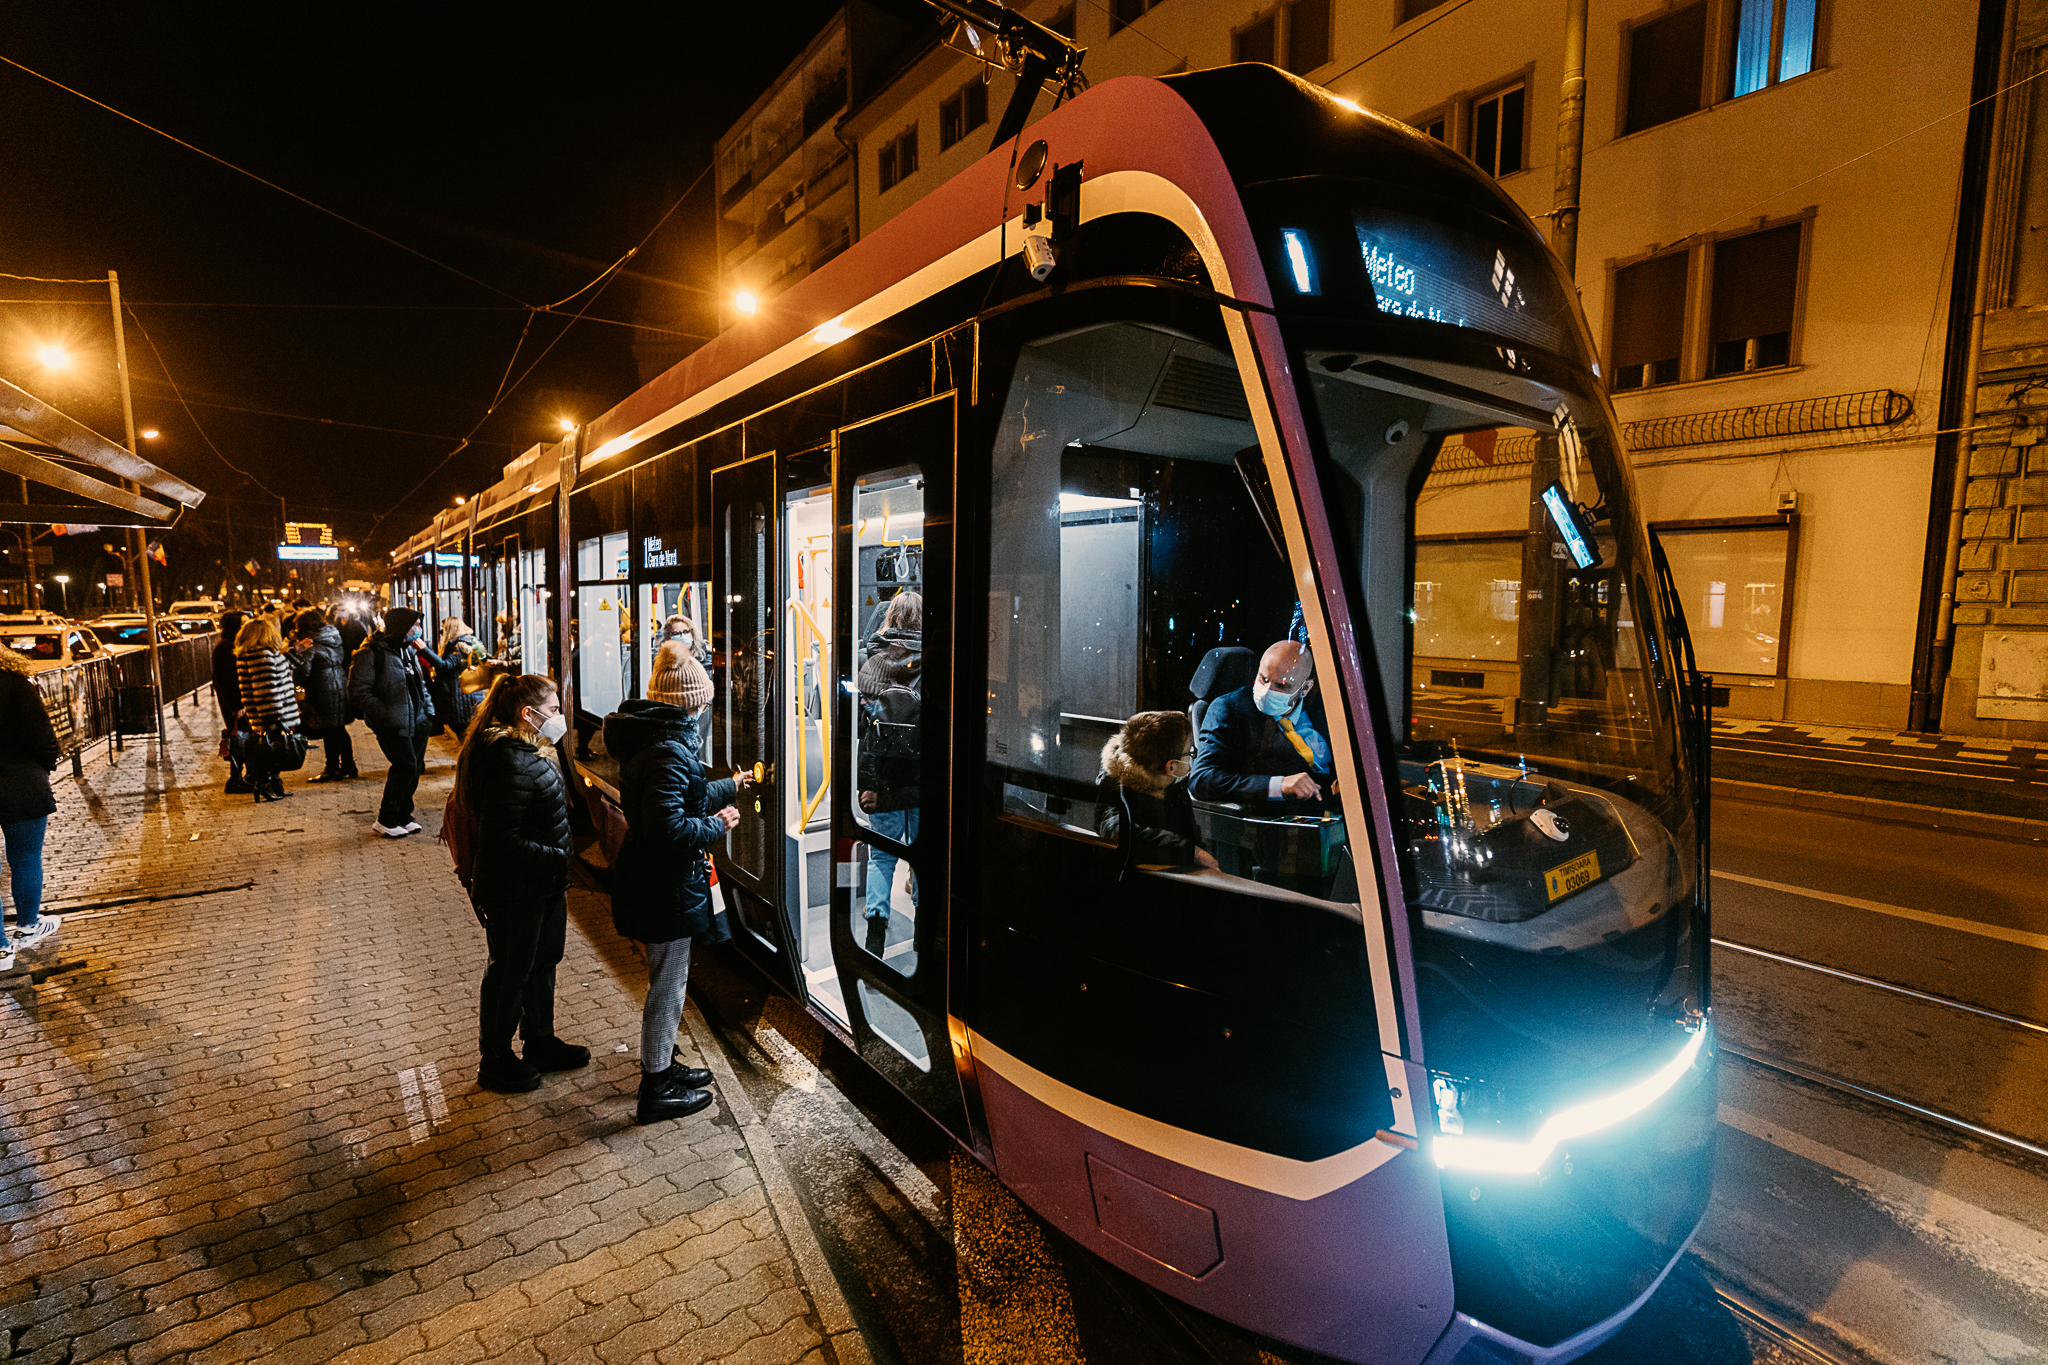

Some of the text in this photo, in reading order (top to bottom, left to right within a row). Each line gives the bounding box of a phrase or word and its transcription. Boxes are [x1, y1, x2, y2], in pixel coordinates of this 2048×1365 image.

[1362, 241, 1415, 295] Meteo
[648, 536, 662, 551] Meteo
[1566, 870, 1590, 891] 03069
